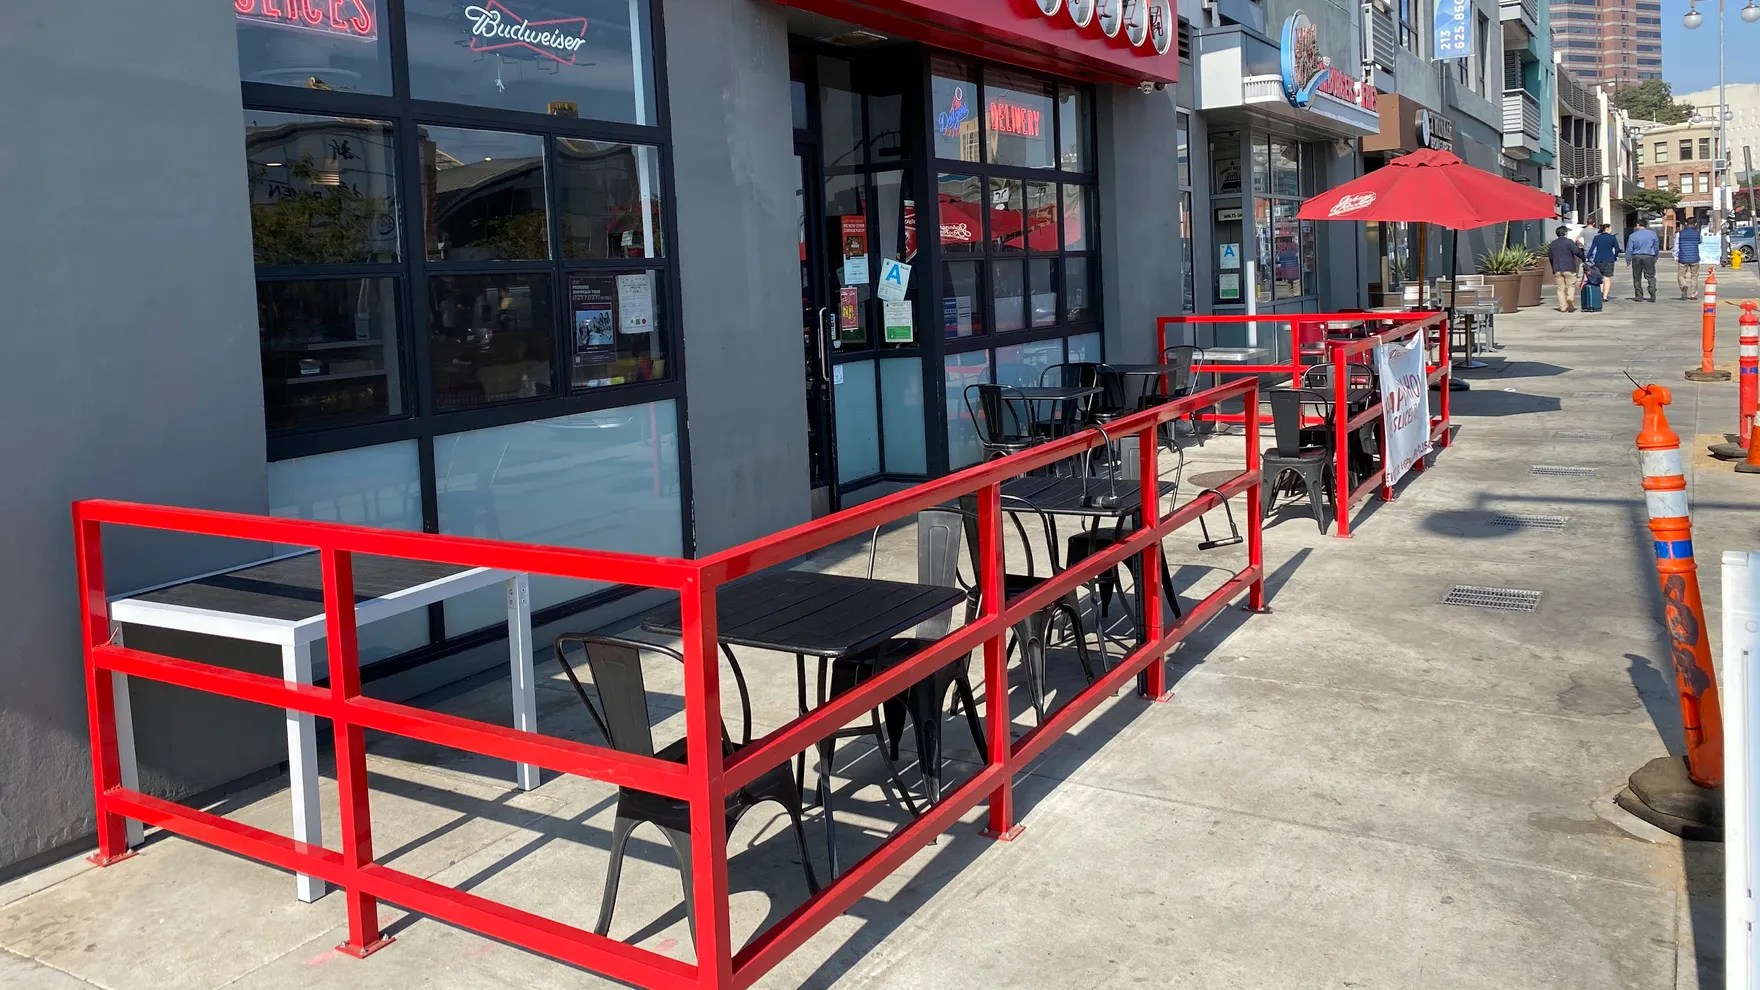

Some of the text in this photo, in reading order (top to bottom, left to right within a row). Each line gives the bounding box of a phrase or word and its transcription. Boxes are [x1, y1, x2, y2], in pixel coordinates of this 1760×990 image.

[235, 0, 371, 34] CES
[465, 5, 586, 51] Budweiser
[1440, 30, 1451, 50] 213
[990, 102, 1040, 137] DELIVERY
[1224, 244, 1235, 257] A
[885, 263, 901, 285] A
